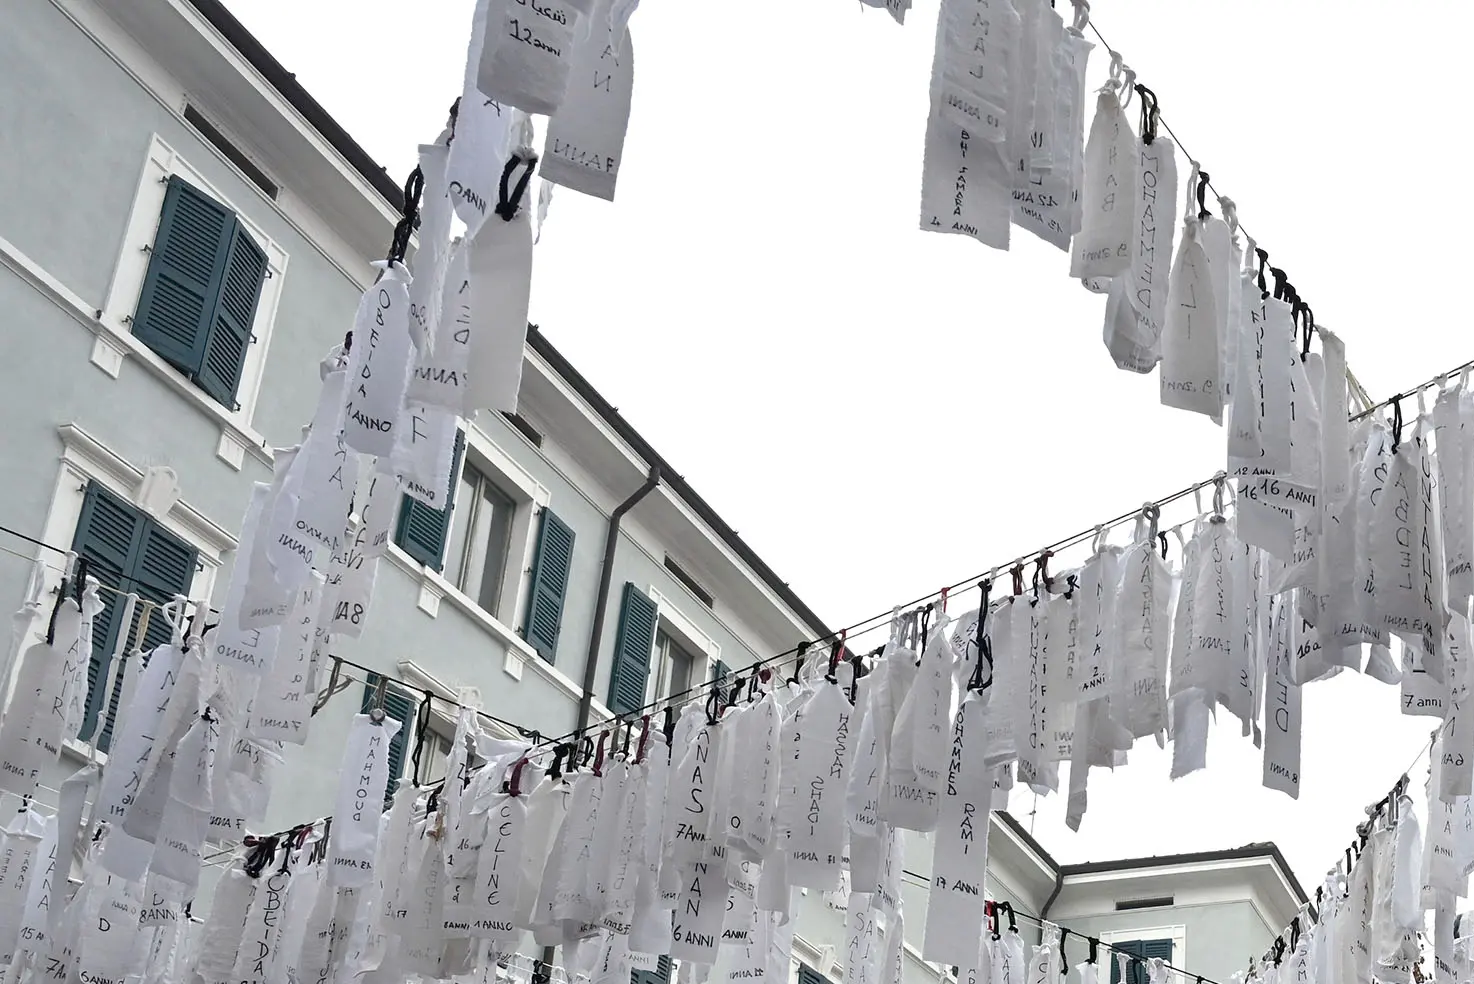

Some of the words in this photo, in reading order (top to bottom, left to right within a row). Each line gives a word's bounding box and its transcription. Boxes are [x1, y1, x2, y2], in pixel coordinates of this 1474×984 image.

[953, 222, 979, 237] ANNI
[357, 288, 391, 399] OBEIDA
[352, 411, 392, 434] ANNO
[1239, 485, 1257, 501] 16
[1260, 481, 1279, 498] 16
[1285, 488, 1316, 508] ANNI
[1405, 695, 1416, 710] 7
[1417, 694, 1443, 709] anni
[685, 728, 711, 815] ANAS
[962, 803, 978, 856] RAMI
[487, 805, 514, 907] CELINE
[684, 931, 715, 948] ANNI
